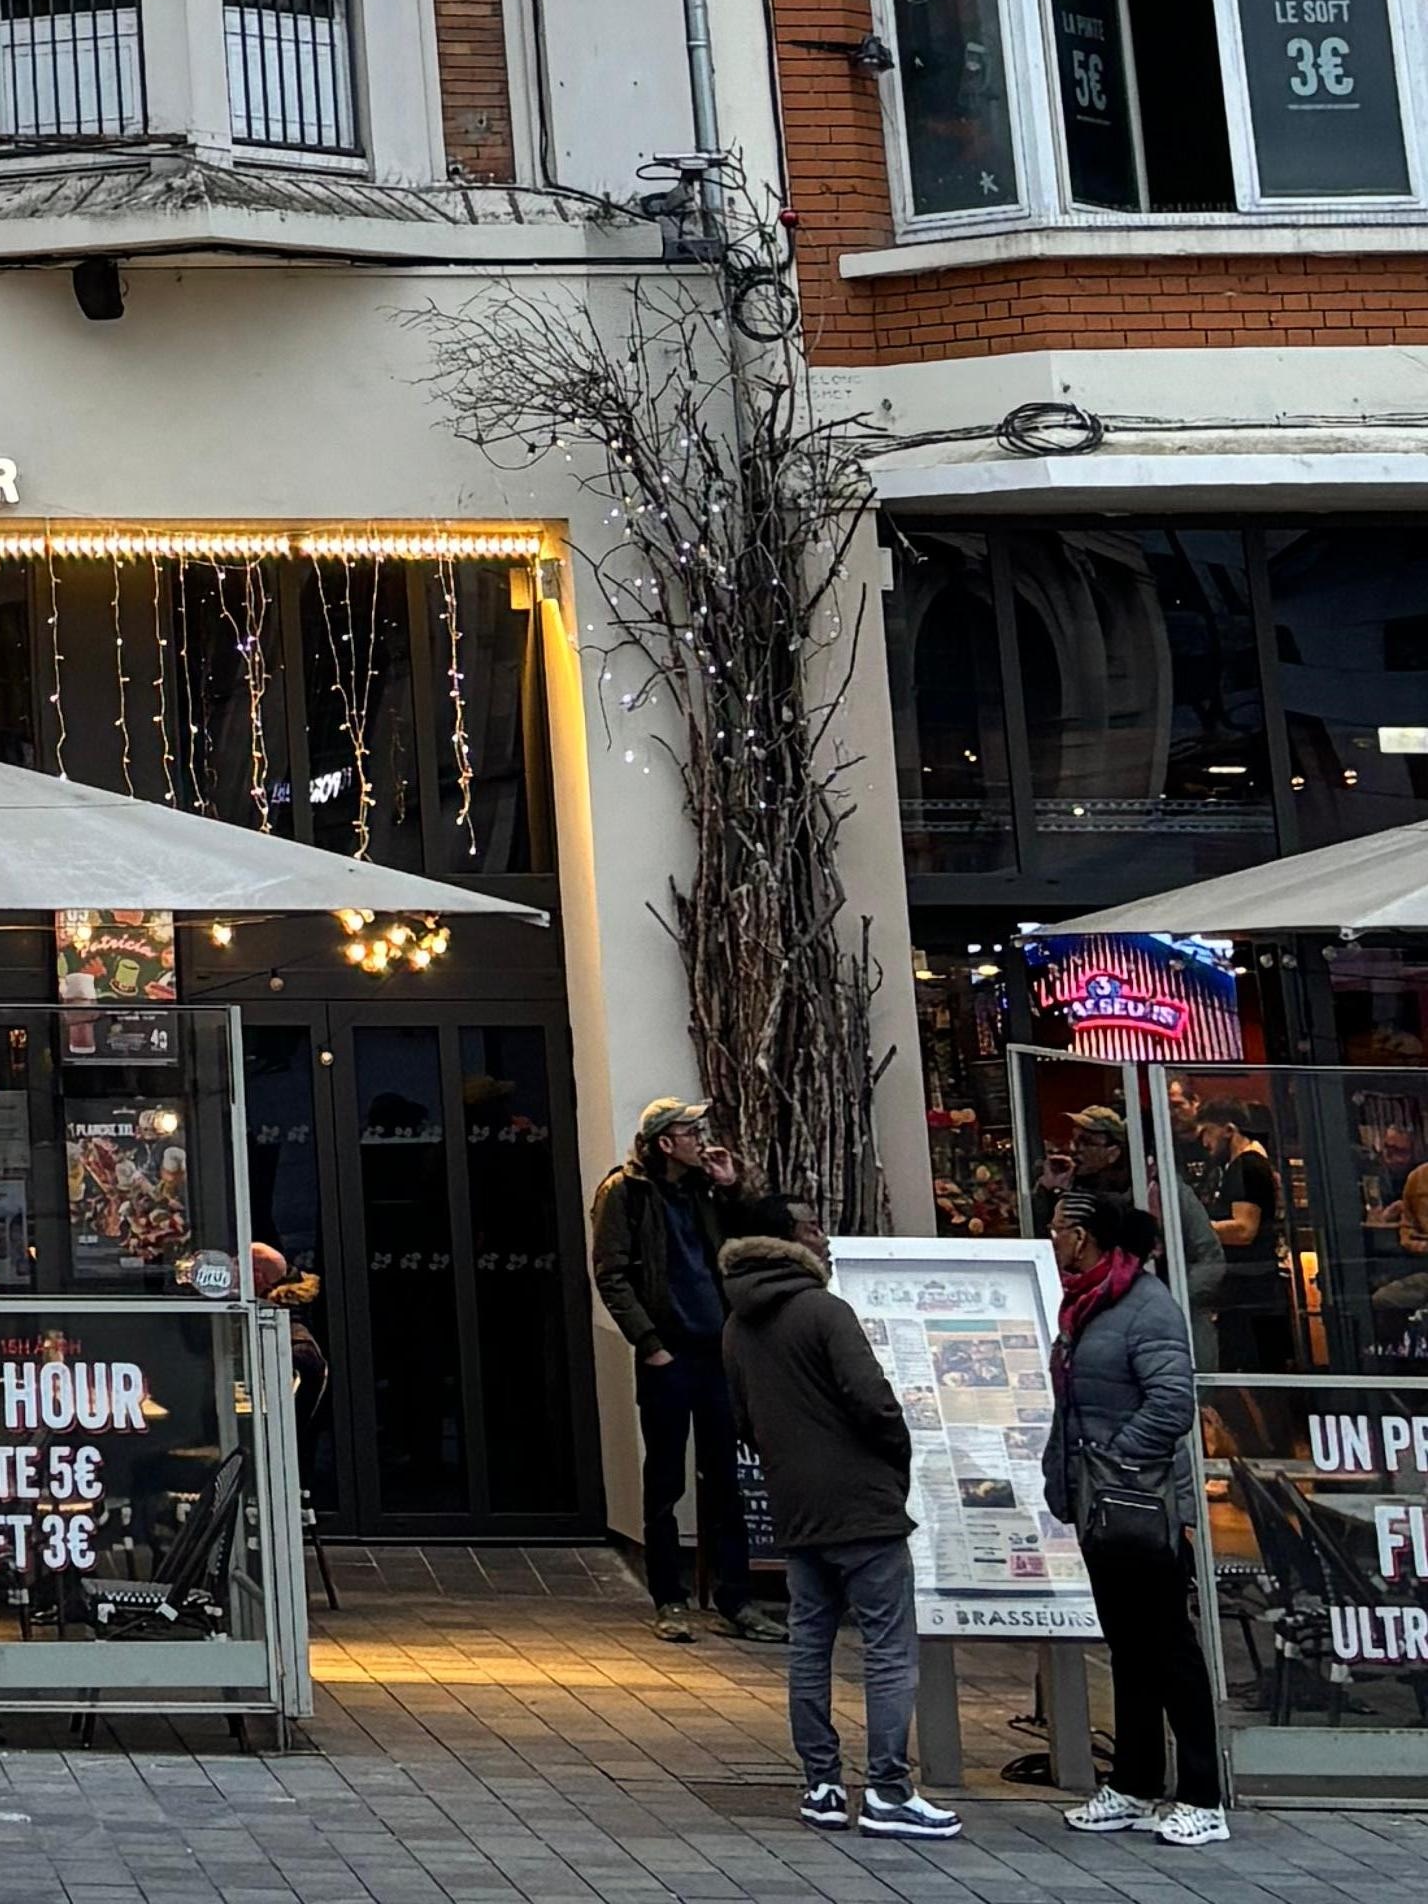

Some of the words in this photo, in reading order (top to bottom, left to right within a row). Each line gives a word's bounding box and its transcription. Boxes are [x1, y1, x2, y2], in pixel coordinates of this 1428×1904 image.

[1275, 0, 1298, 24] LE
[1303, 0, 1351, 24] SOFT
[1072, 49, 1107, 111] 5€
[1287, 37, 1355, 97] 3€
[1092, 976, 1113, 996] 3
[3, 1361, 148, 1431] HOUR
[1308, 1414, 1374, 1473] UN
[48, 1445, 105, 1501] 5€
[41, 1513, 97, 1571] 3€
[955, 1610, 1097, 1628] BRASSEURS
[1330, 1605, 1428, 1661] ULTR
